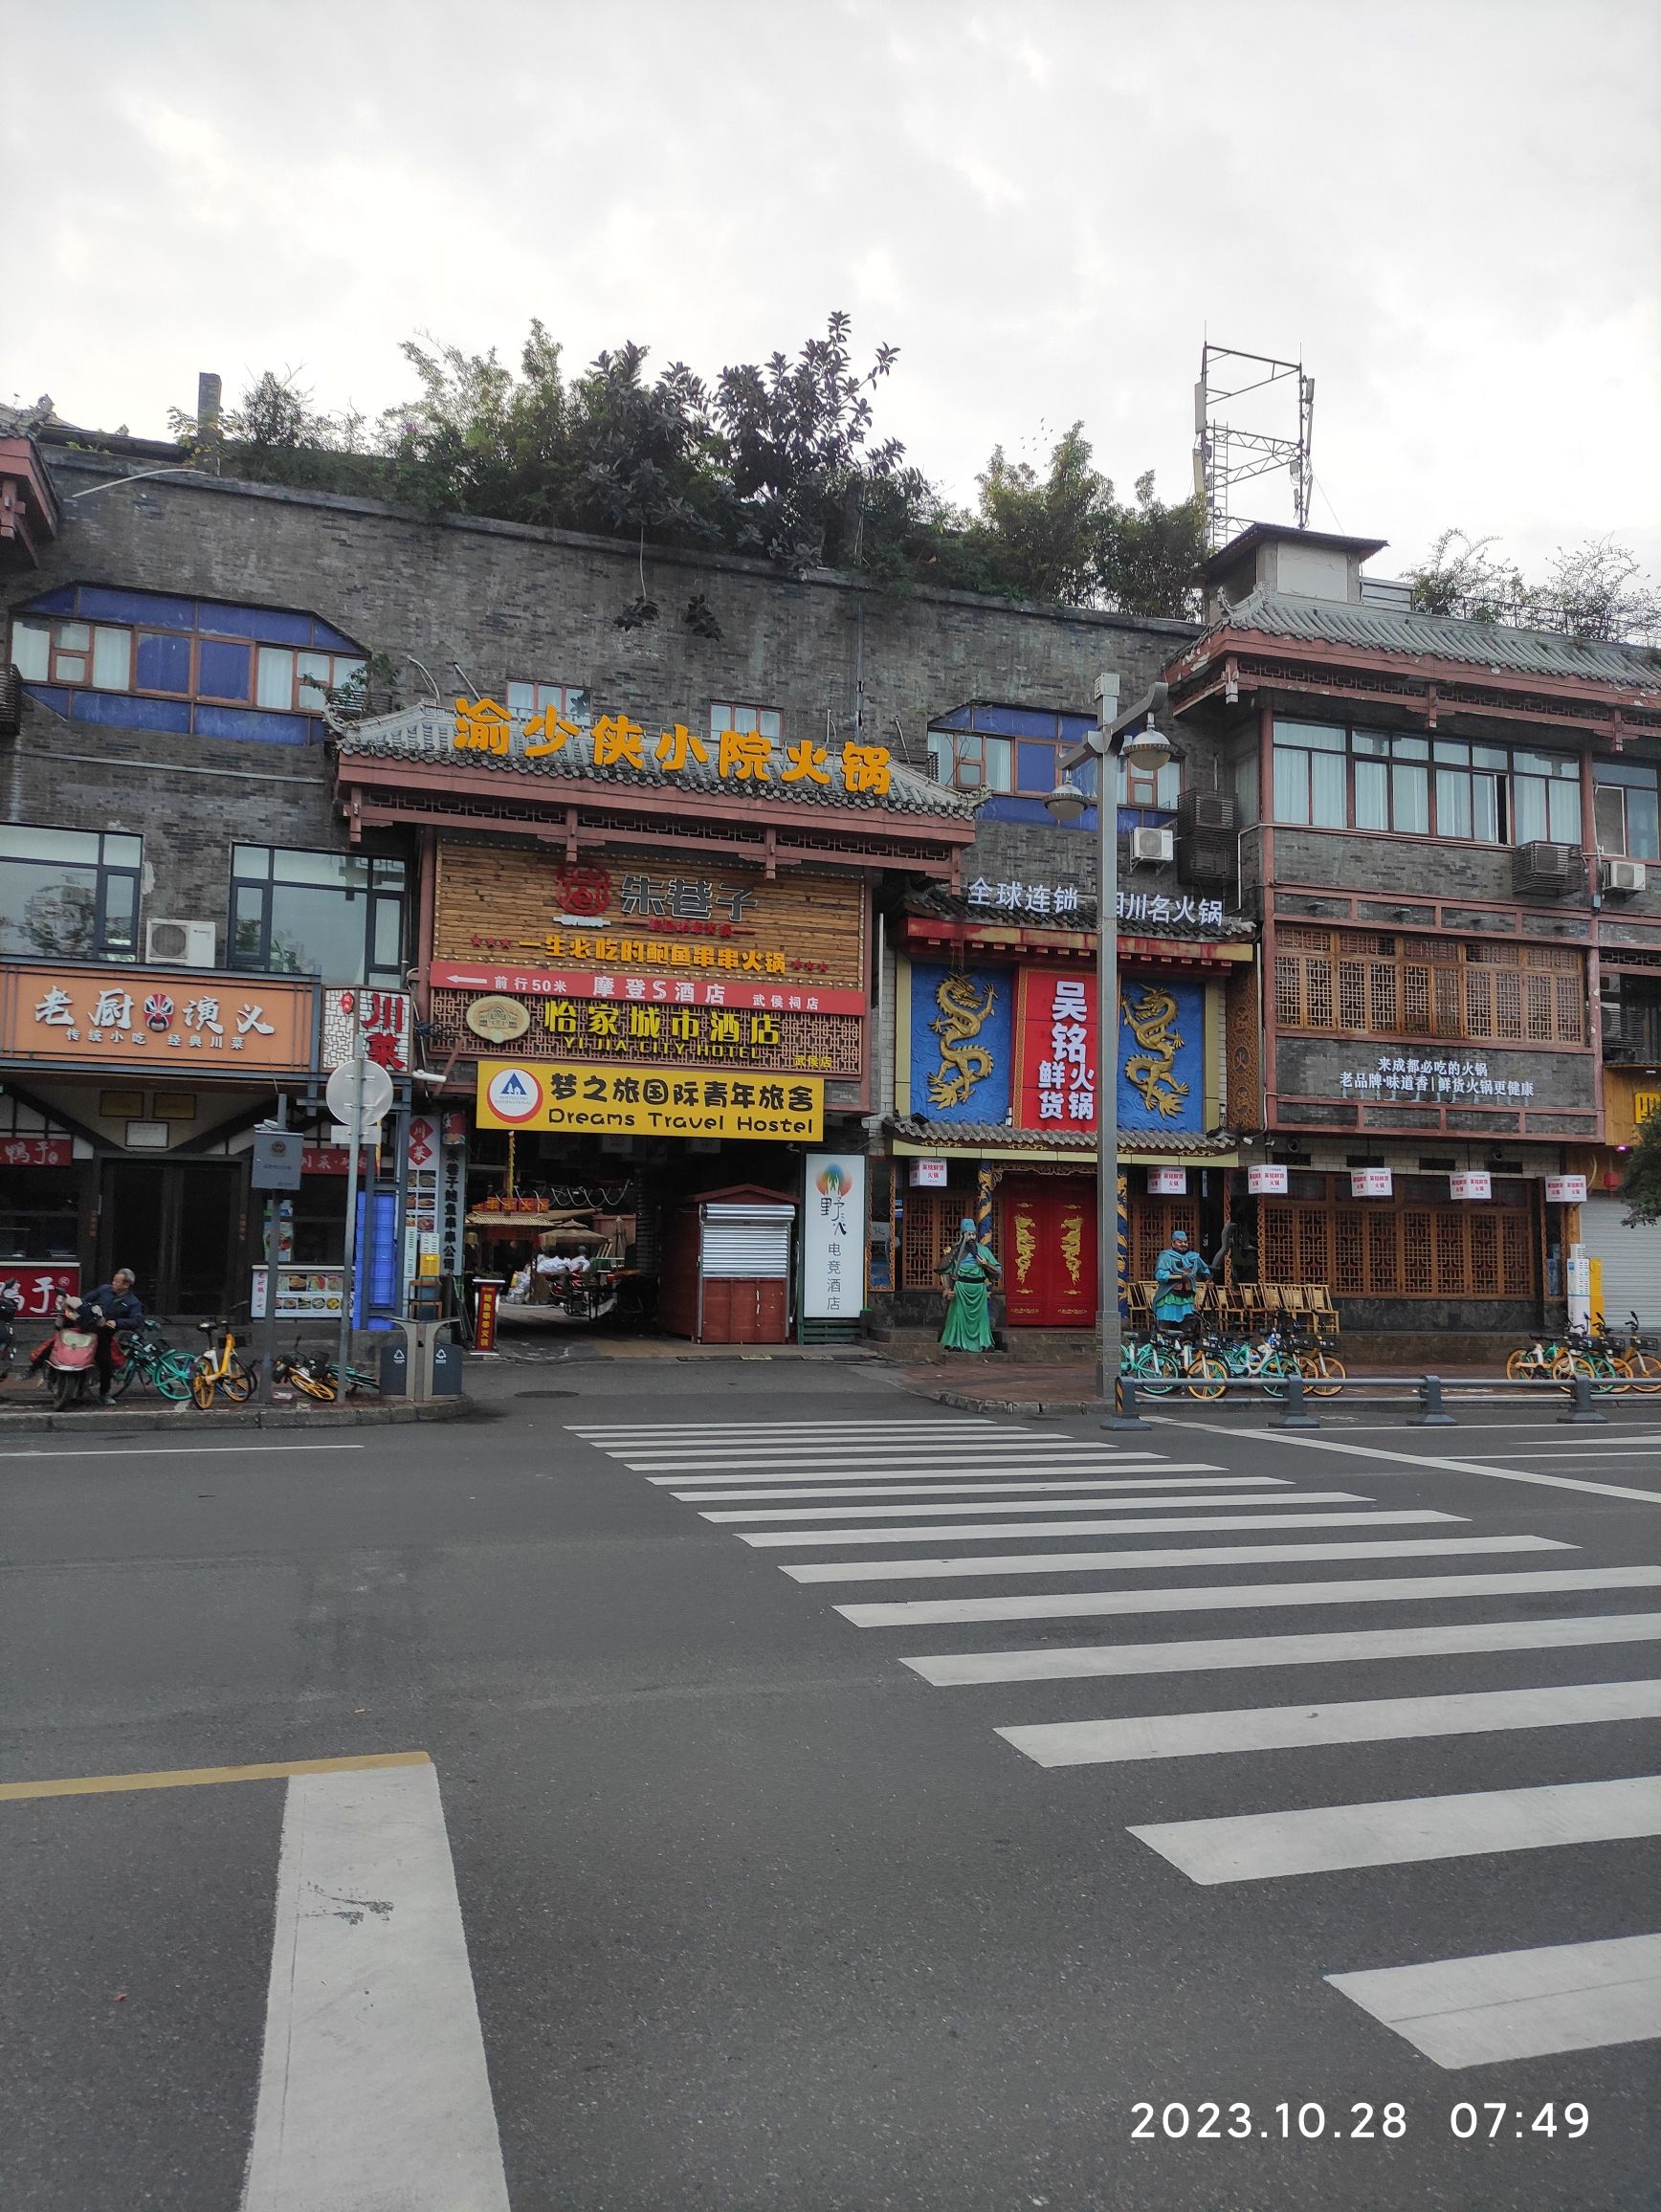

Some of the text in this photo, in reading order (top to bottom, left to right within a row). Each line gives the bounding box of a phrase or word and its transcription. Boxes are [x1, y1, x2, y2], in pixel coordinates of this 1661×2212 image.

[454, 697, 891, 795] 渝少侠小院火锅
[622, 874, 758, 921] 朱巷子
[968, 876, 1078, 914] 全球连锁
[519, 934, 786, 974] 一生必吃的鲍鱼串串火锅
[494, 975, 819, 1011] 前行50米 摩登S酒店 武侯祠店
[66, 1028, 245, 1050] 传统小吃 经典川菜
[362, 991, 406, 1070] 川菜
[544, 1001, 781, 1046] 怡家城市酒店
[1052, 980, 1087, 1063] 吴铭
[564, 1037, 761, 1060] YI JIA CITY HOTEL
[1378, 1056, 1488, 1077] 来成都必吃的火锅
[550, 1073, 813, 1112] 梦之旅国际青年旅舍
[1038, 1060, 1066, 1119] 鲜货
[1068, 1063, 1095, 1120] 火锅
[548, 1108, 813, 1135] Dreams Travel Hostel
[827, 1242, 841, 1312] 电竞酒店
